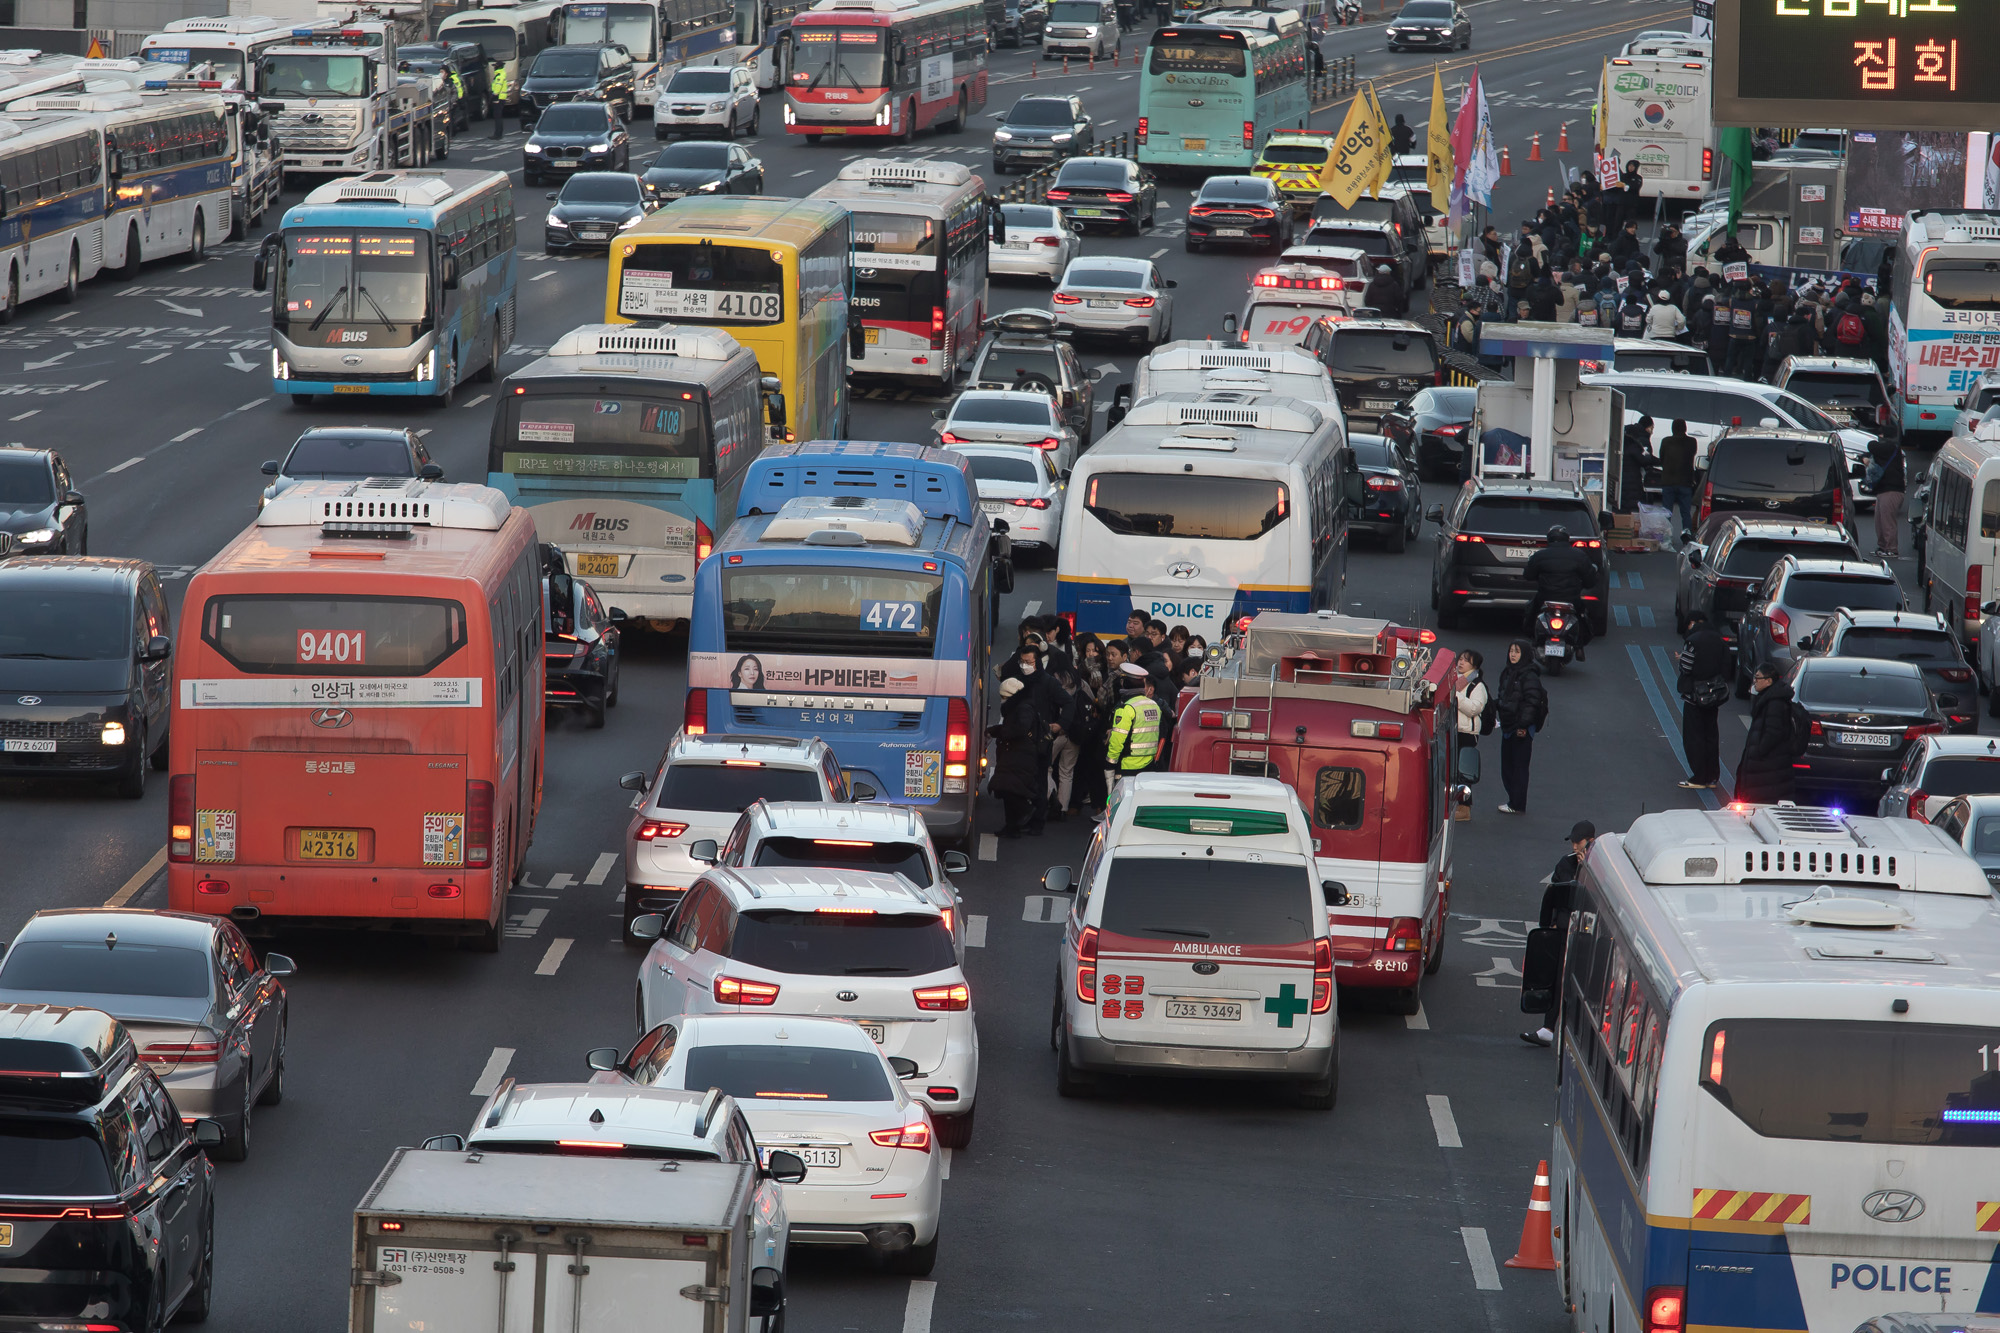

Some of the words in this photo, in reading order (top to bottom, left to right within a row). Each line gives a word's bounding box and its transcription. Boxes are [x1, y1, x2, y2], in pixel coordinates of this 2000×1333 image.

[1162, 48, 1196, 59] VIP
[1177, 76, 1207, 85] Good
[1209, 77, 1229, 86] Bus
[1616, 75, 1653, 89] 국민이
[1654, 82, 1699, 96] 주인이다!
[856, 232, 881, 244] 4101
[625, 291, 649, 310] 동탄신도시
[683, 294, 707, 306] 서울역
[718, 294, 778, 317] 4108
[1264, 316, 1311, 335] 119
[1953, 333, 1982, 345] 반헌법
[519, 458, 550, 470] IRP도
[552, 458, 609, 473] 연말정산도
[614, 460, 684, 475] 하나은행에서!
[582, 532, 615, 542] 대원고속
[666, 526, 684, 535] 주의
[587, 563, 617, 575] 2407
[866, 602, 916, 629] 472
[1152, 602, 1214, 619] POLICE
[300, 632, 362, 662] 9401
[766, 670, 802, 681] 한고은의
[805, 669, 887, 689] HP비타란
[312, 682, 355, 699] 인상파
[359, 683, 383, 691] 모네에서
[384, 683, 408, 691] 미국으로
[767, 695, 889, 710] HYUNDAI
[800, 712, 854, 725] 도선여객
[6, 741, 30, 750] 177호
[32, 742, 55, 751] 6207
[1868, 736, 1889, 745] 9055
[306, 760, 356, 774] 동성교통
[906, 754, 924, 768] 주의
[216, 814, 234, 830] 주의
[425, 816, 444, 833] 주의
[314, 832, 329, 840] 서울
[332, 832, 345, 840] 74
[425, 834, 444, 843] 우회전시
[302, 841, 313, 853] 사
[314, 842, 355, 858] 2316
[1173, 943, 1241, 956] AMBULANCE
[1374, 959, 1408, 972] 용산10
[1102, 974, 1145, 995] 응급
[840, 992, 855, 1000] KIA
[1102, 999, 1145, 1020] 출동
[1173, 1003, 1198, 1016] 73조
[1203, 1005, 1234, 1018] 9349
[804, 1152, 837, 1165] 5113
[411, 1250, 467, 1265] (주)신안특장
[1695, 1264, 1755, 1274] UNIVERSE
[1831, 1263, 1951, 1293] POLICE
